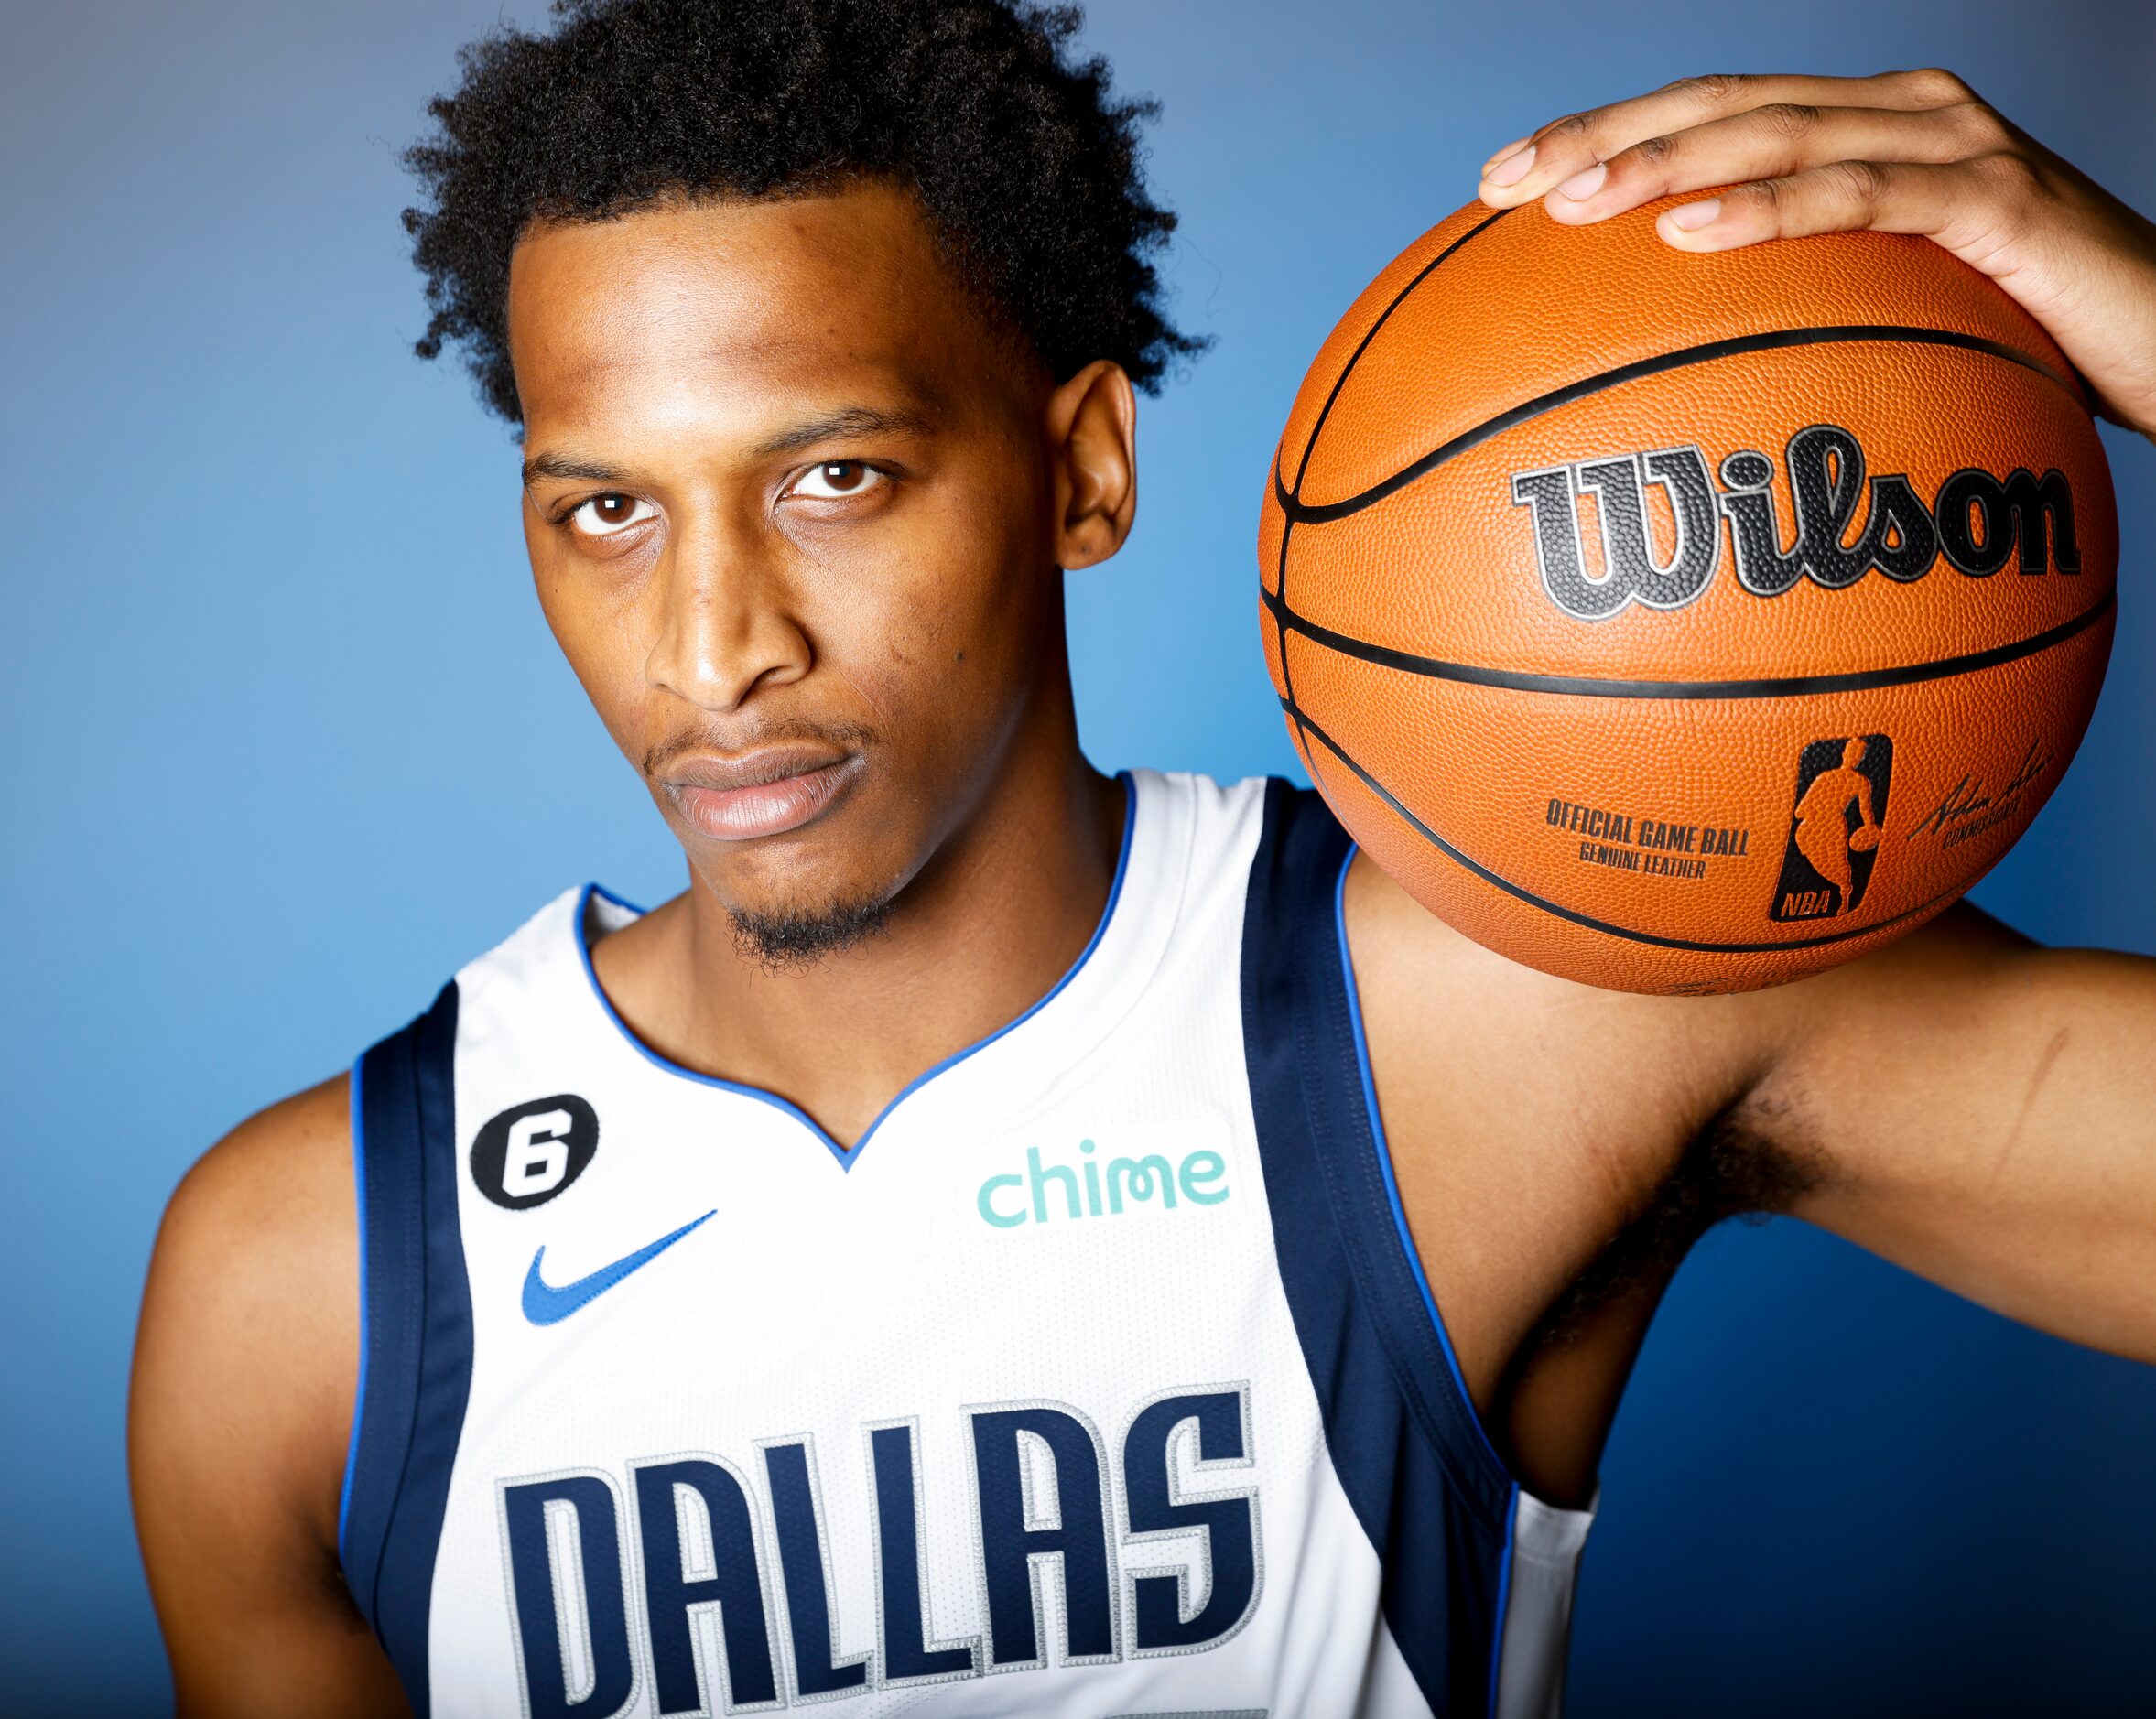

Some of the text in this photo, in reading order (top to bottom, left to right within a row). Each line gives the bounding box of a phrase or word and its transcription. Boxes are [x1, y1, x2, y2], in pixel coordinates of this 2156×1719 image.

[1510, 424, 2082, 622] Wilson
[1545, 798, 1750, 856] OFFICIAL GAME BALL
[1579, 841, 1706, 879] GENUINE LEATHER
[1780, 889, 1831, 917] NBA
[502, 1108, 573, 1198] 6
[976, 1139, 1230, 1228] chime
[495, 1379, 1262, 1719] DALLAS
